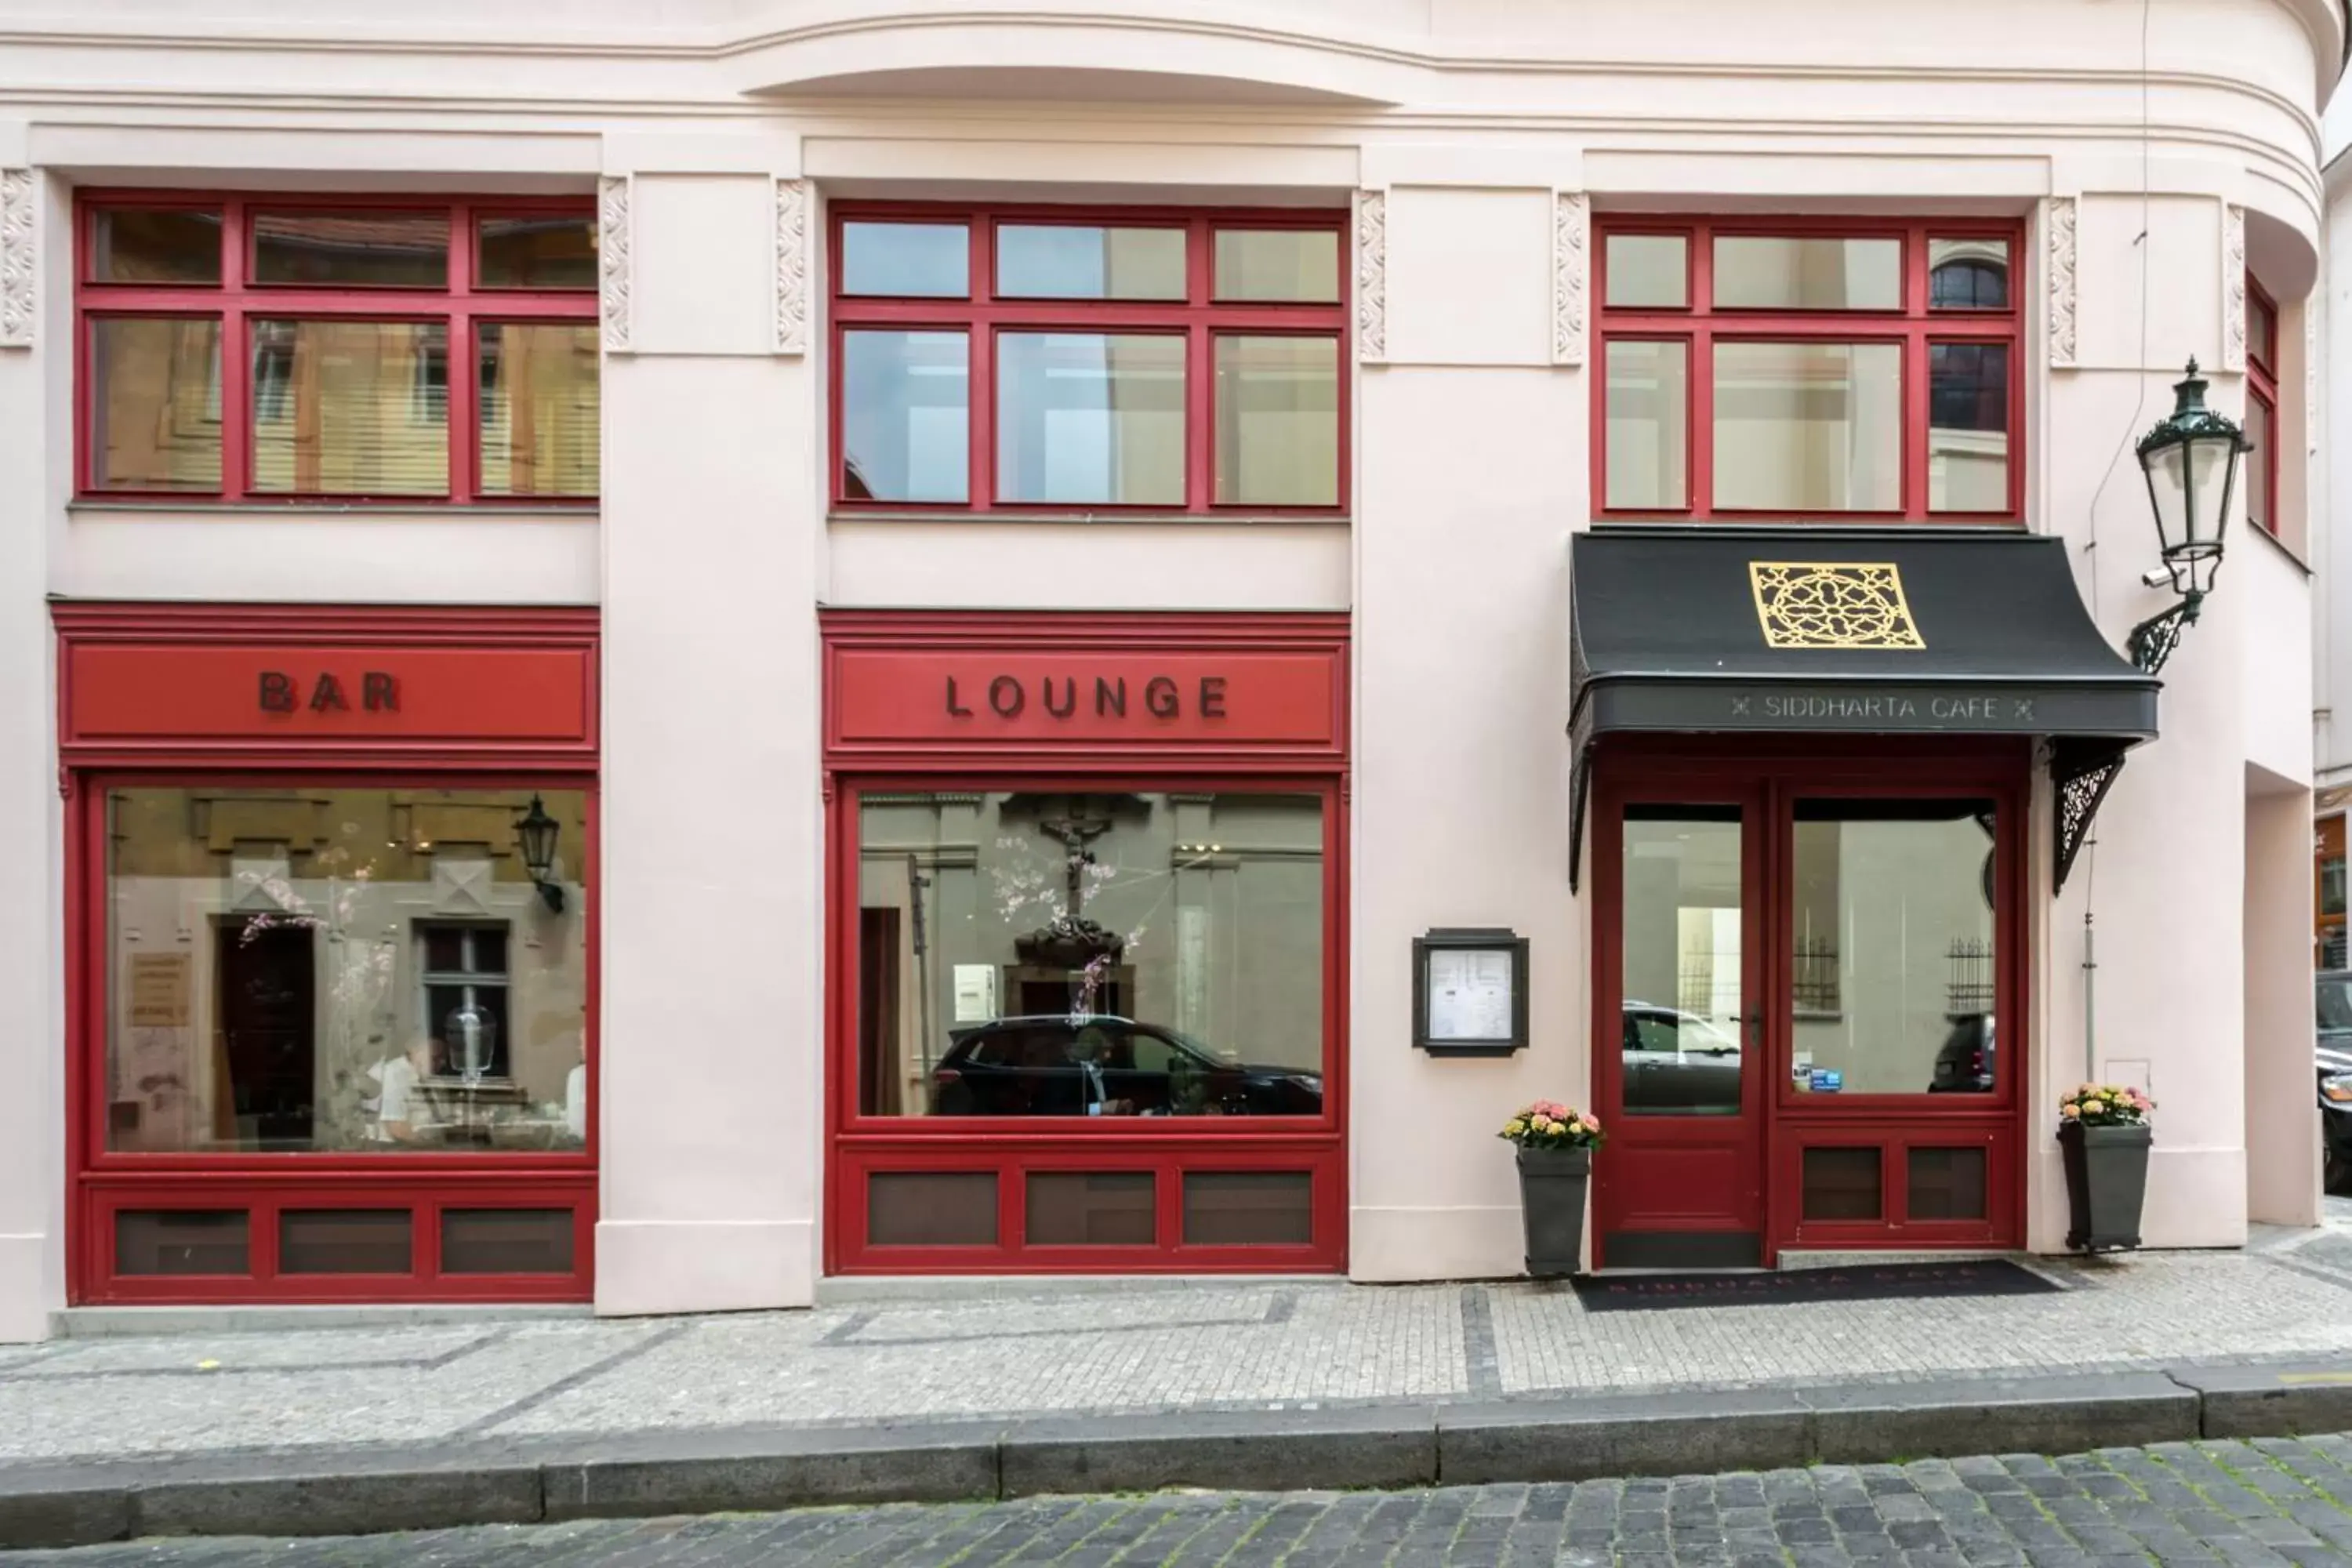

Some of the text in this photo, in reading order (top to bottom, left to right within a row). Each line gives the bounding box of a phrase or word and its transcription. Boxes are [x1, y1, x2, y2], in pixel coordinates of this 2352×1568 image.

[260, 671, 401, 713] BAR
[946, 675, 1227, 718] LOUNGE
[1764, 696, 1998, 718] SIDDHARTA CAFE
